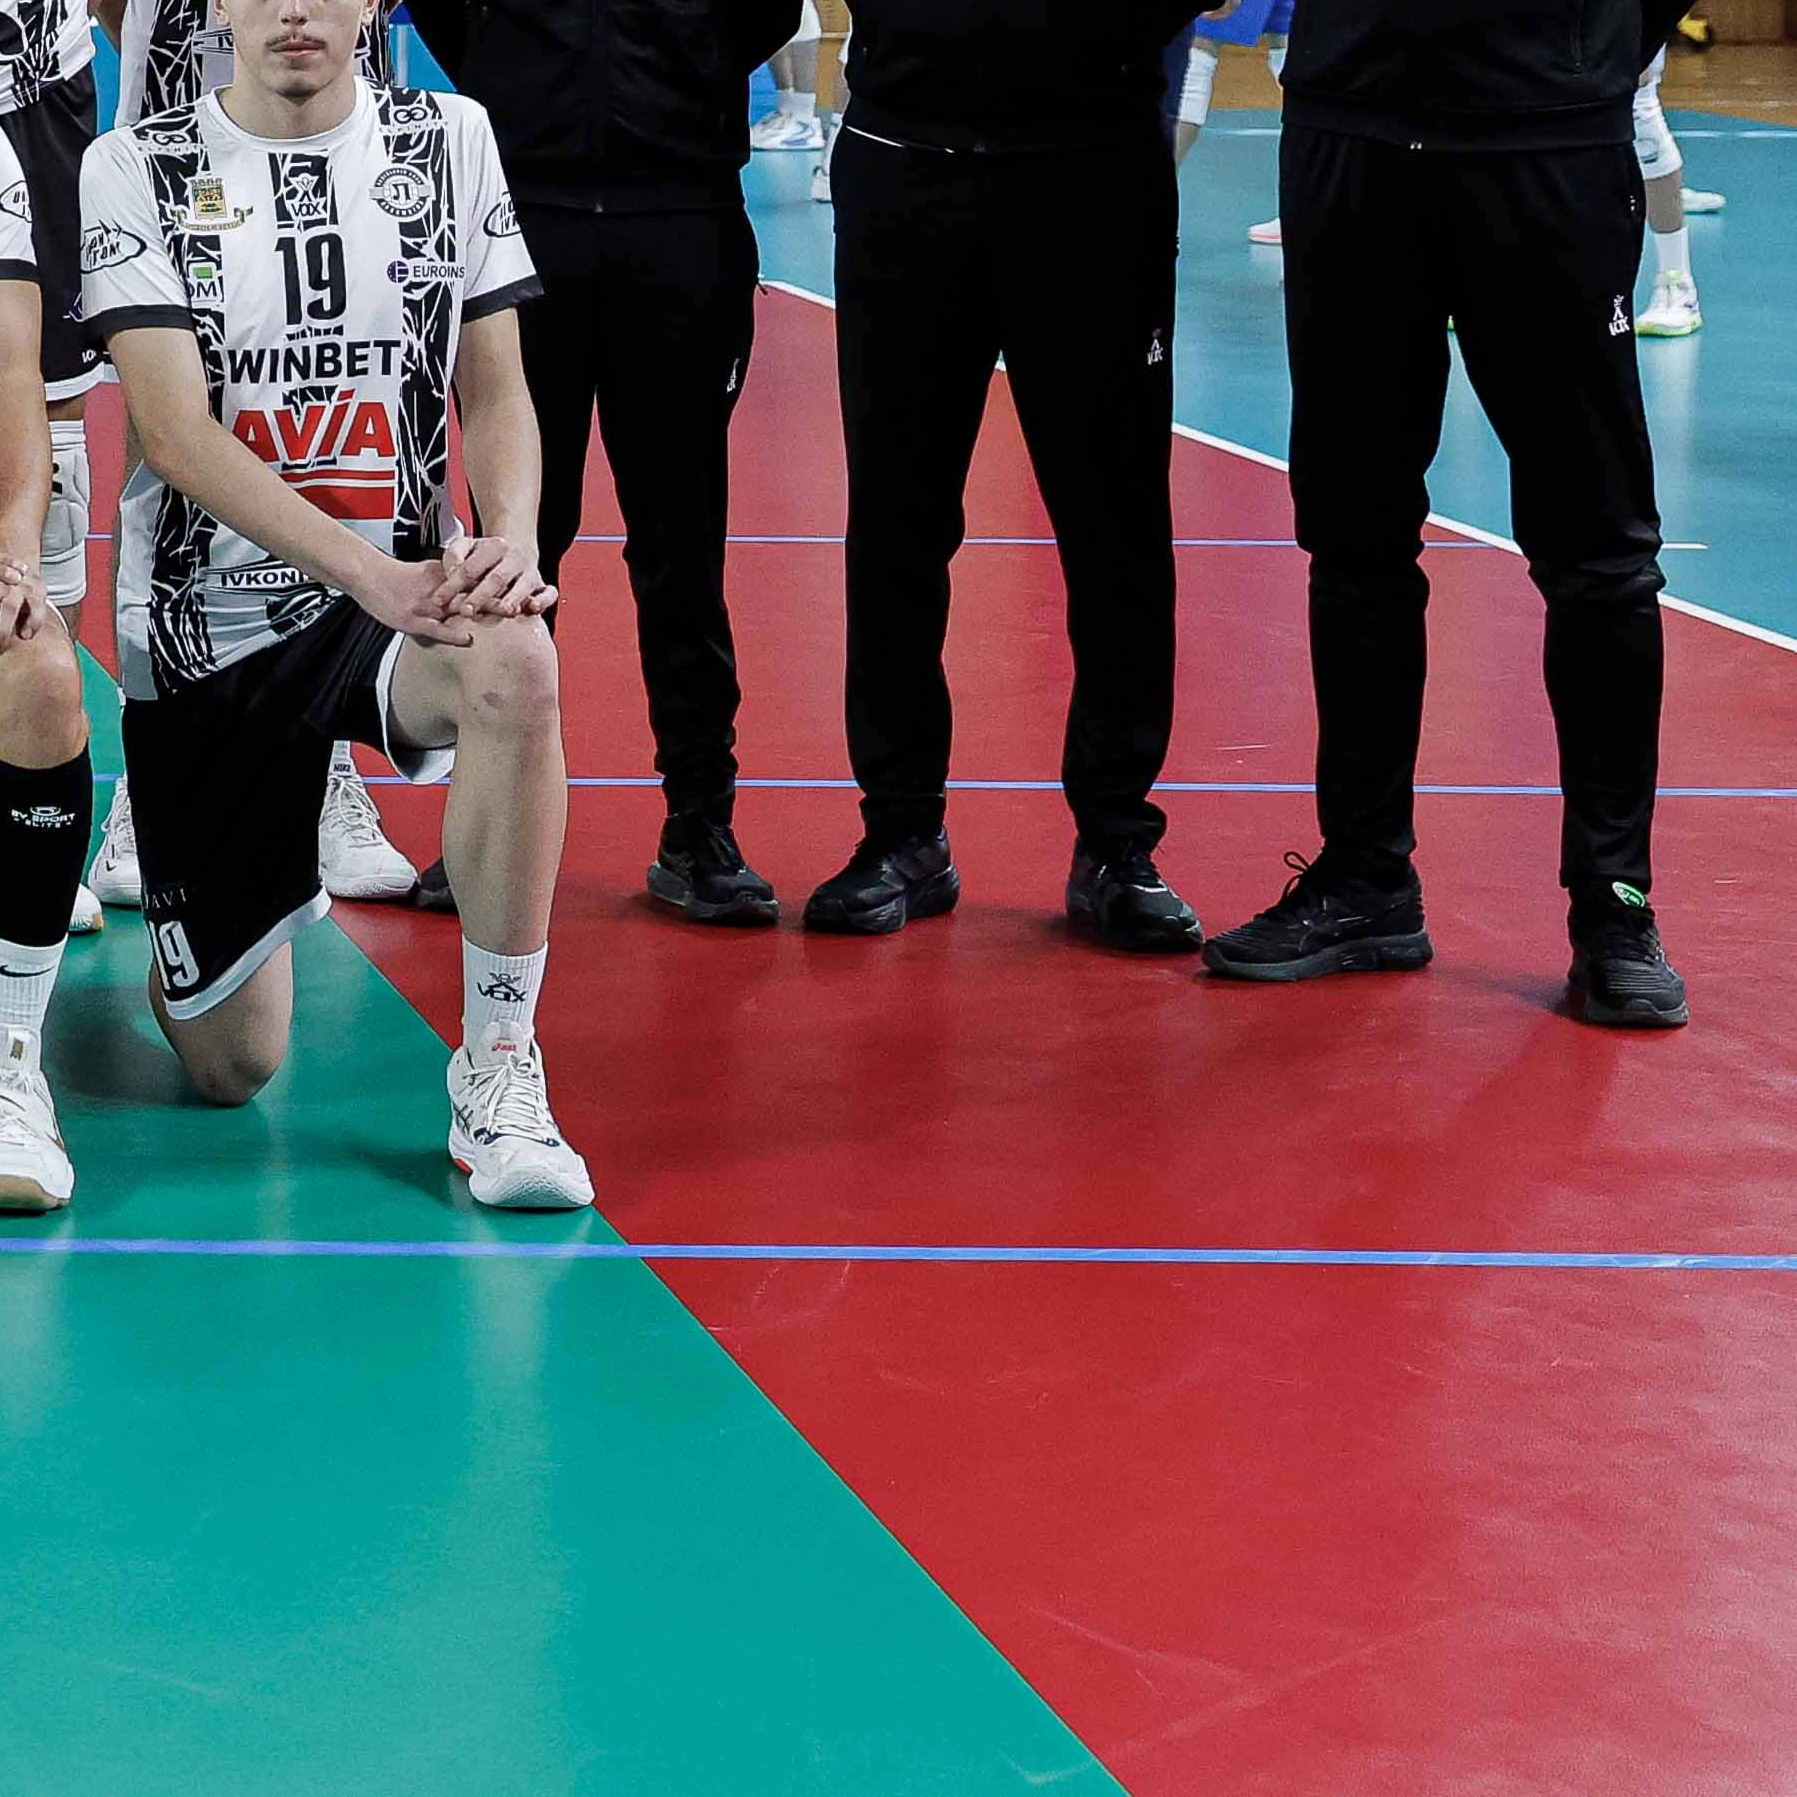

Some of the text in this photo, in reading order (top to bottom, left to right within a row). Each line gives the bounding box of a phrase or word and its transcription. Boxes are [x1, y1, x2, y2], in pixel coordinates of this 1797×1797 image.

[275, 234, 346, 326] 19
[414, 264, 465, 280] EUROINS
[229, 340, 400, 384] WINBET
[221, 570, 304, 588] IVKONI
[148, 920, 200, 991] 19
